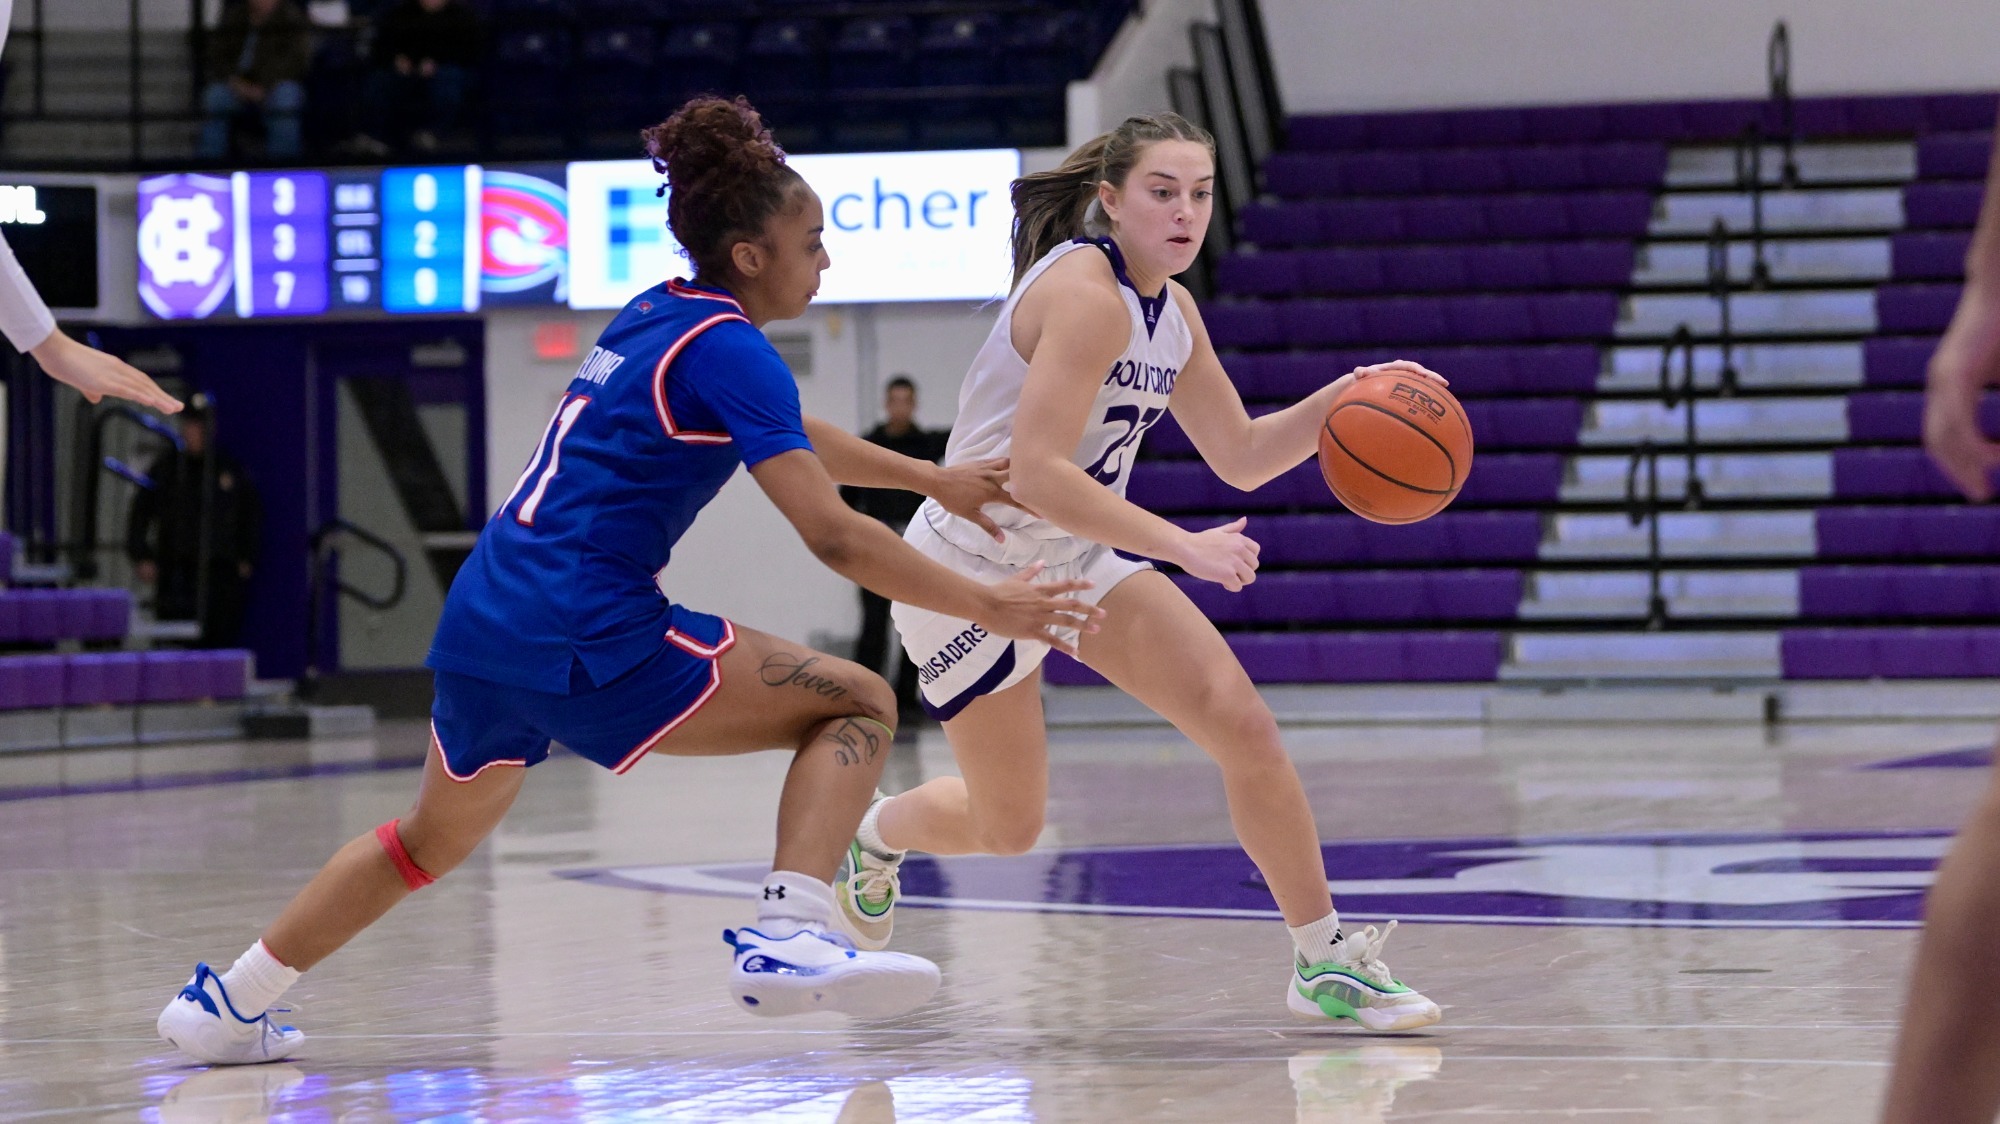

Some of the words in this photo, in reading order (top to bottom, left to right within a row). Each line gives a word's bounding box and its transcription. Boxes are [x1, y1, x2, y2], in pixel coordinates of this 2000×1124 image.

[272, 177, 296, 216] 3
[831, 177, 988, 231] cher
[272, 223, 296, 262] 3
[413, 220, 437, 259] 2
[272, 271, 296, 309] 7
[1392, 382, 1446, 417] PRO
[755, 652, 848, 701] Seven
